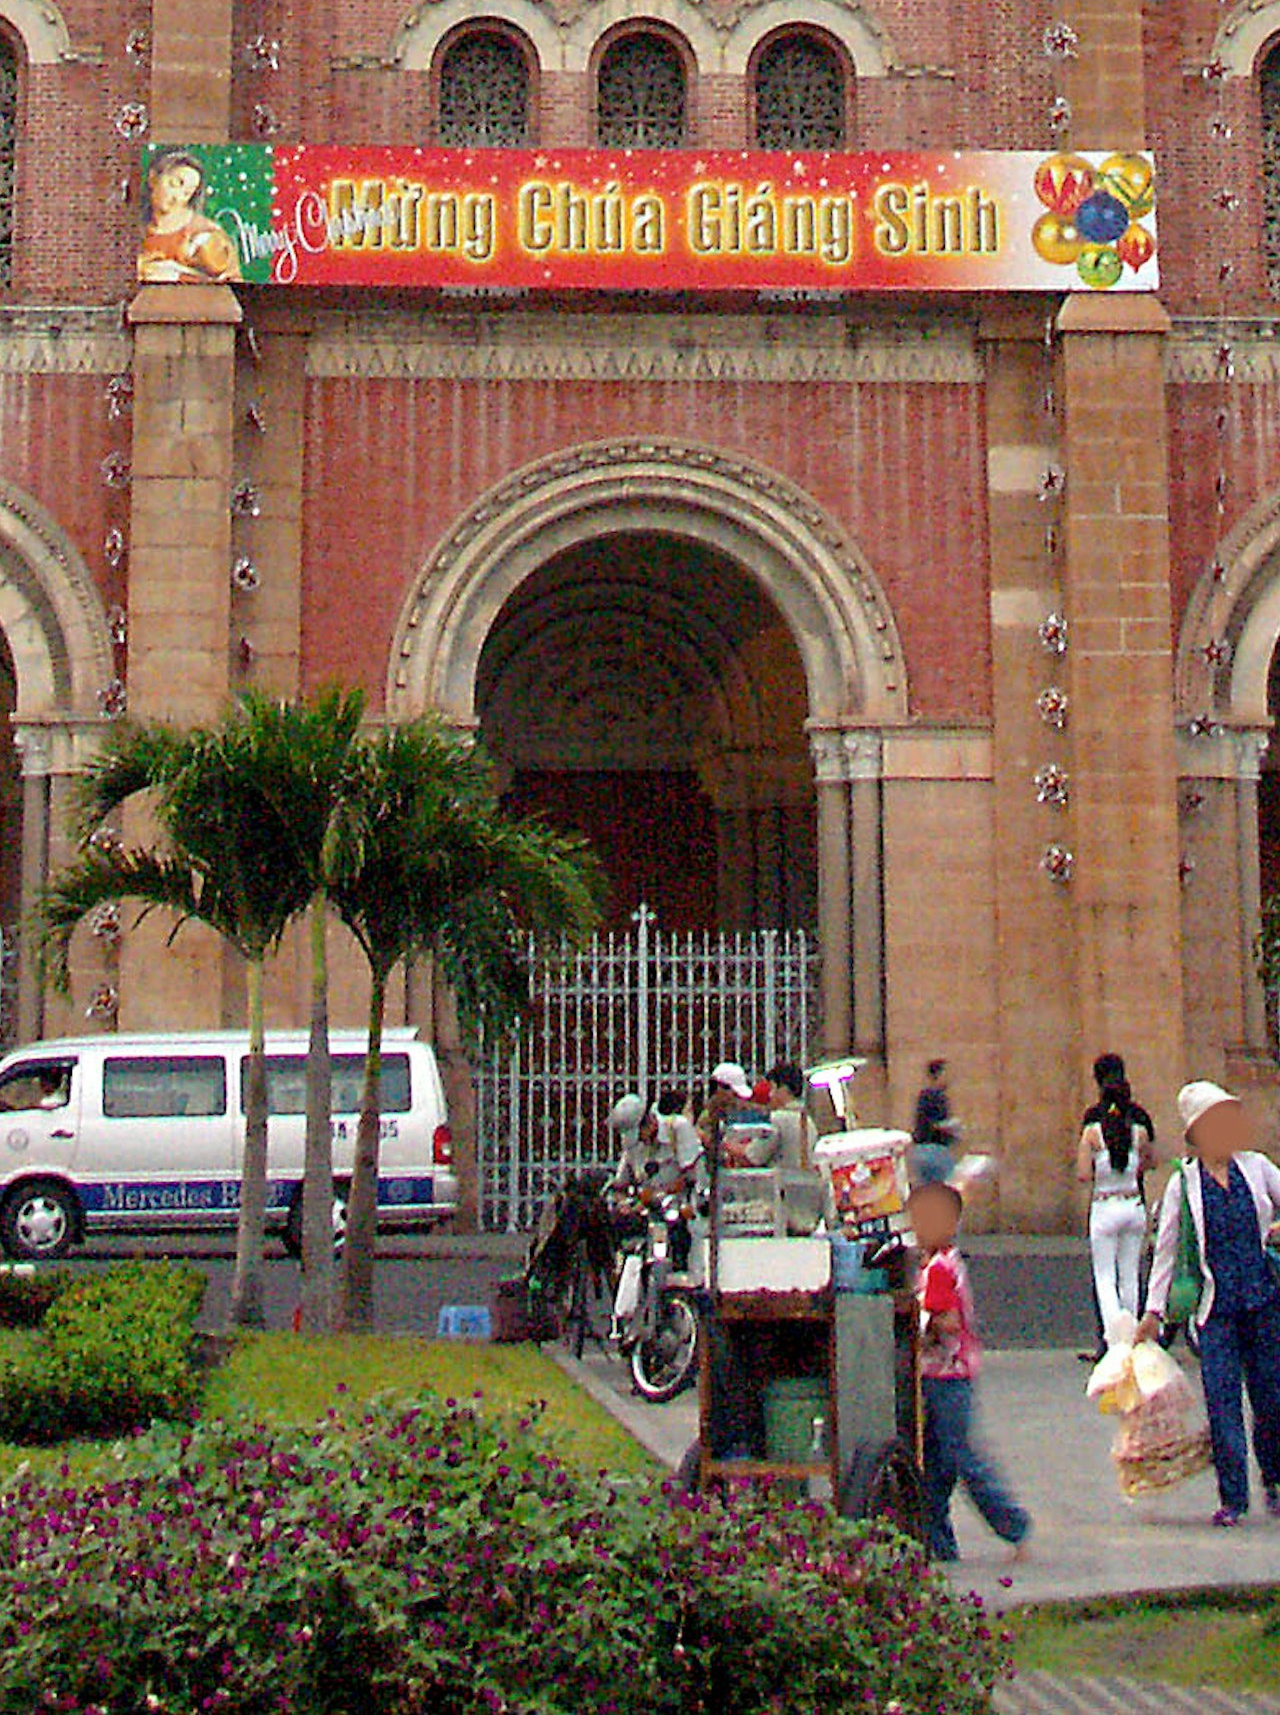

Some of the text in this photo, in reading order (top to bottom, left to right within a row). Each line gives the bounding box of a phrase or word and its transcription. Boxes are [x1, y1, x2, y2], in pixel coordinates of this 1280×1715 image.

[330, 176, 1001, 266] Mừng Chúa Giáng Sinh
